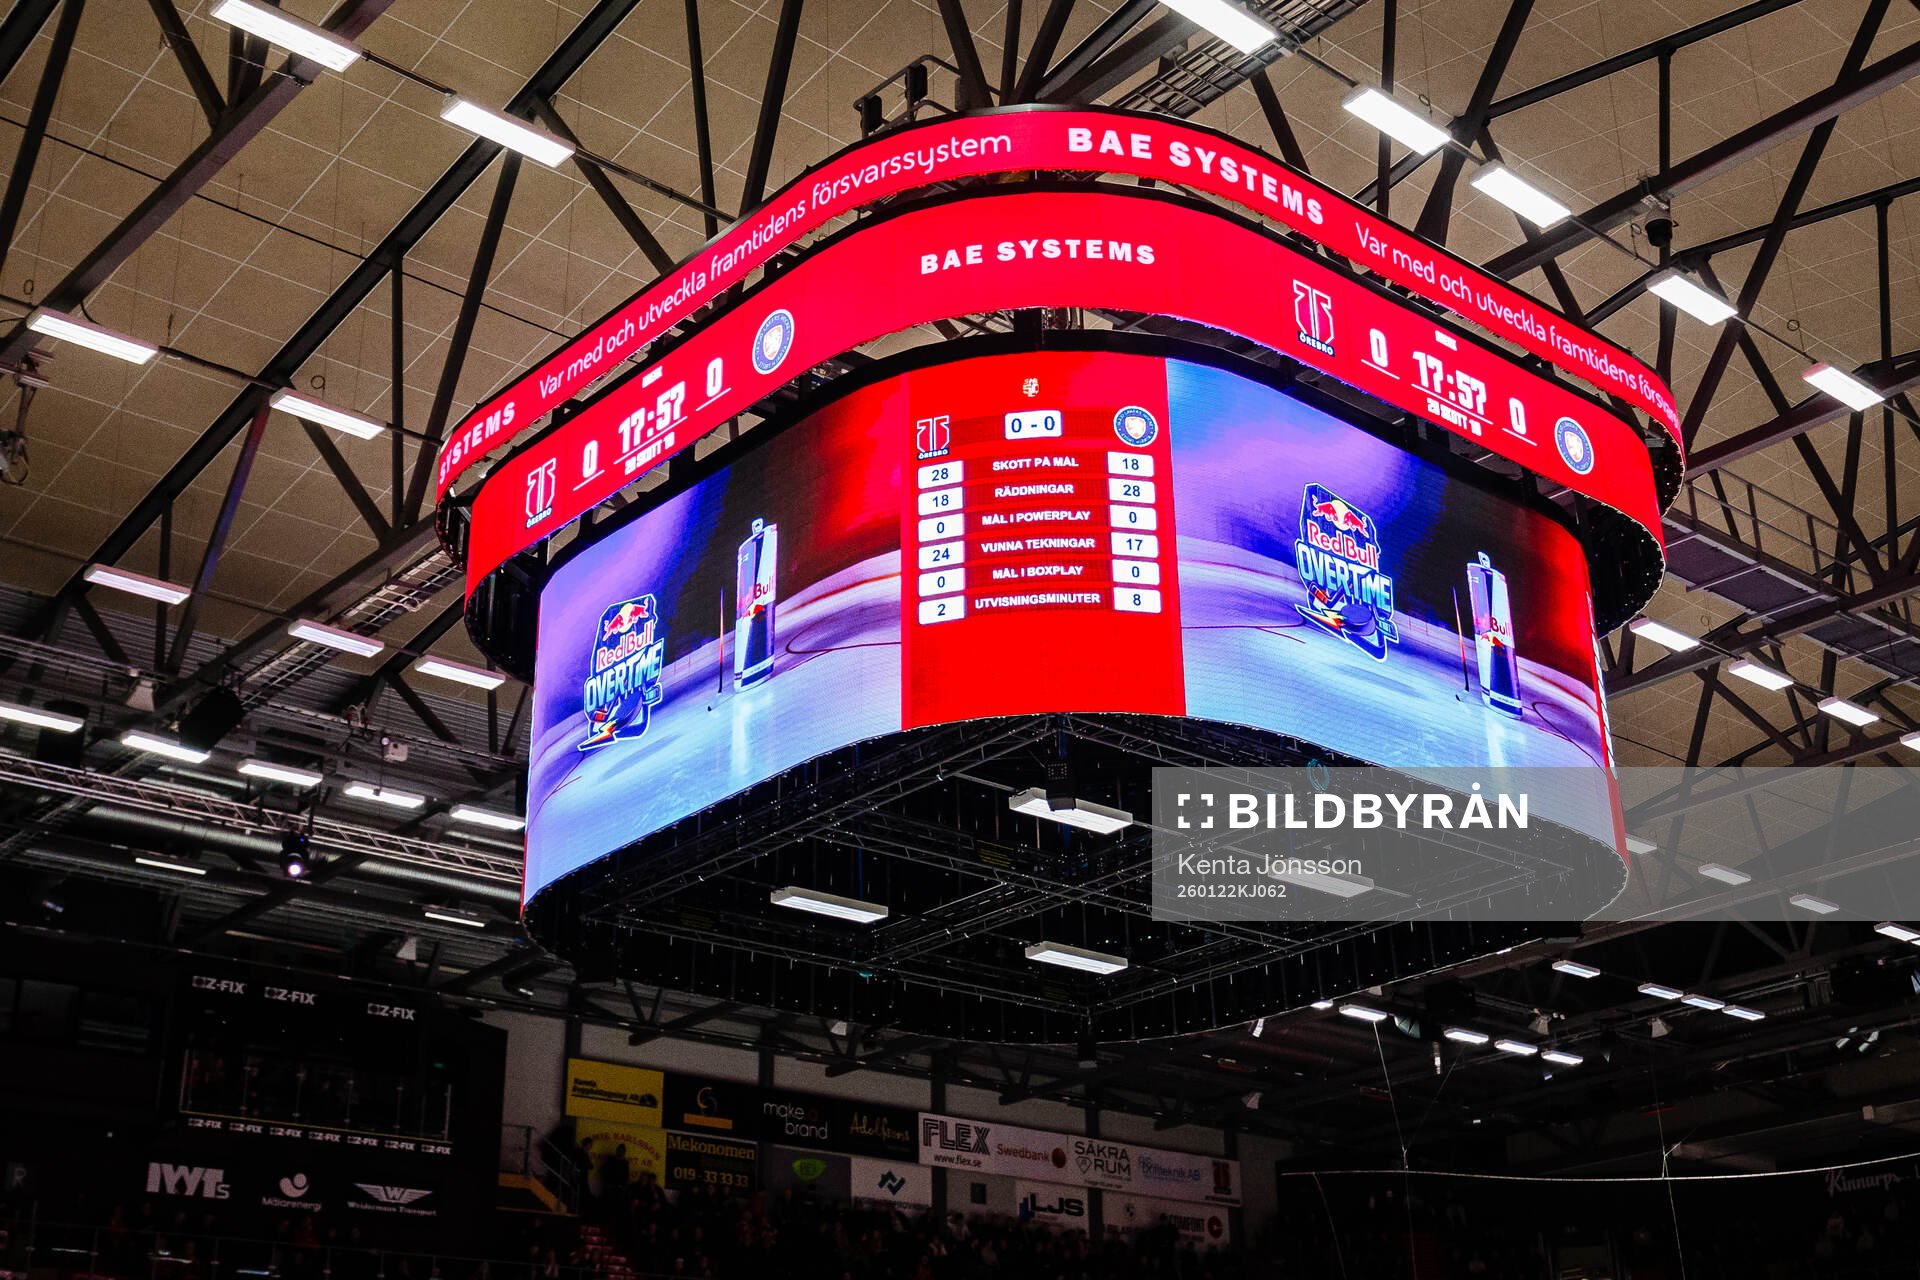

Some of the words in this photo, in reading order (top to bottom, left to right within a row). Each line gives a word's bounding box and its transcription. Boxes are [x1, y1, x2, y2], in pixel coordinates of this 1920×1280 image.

[539, 369, 564, 399] Var
[567, 337, 603, 382] med
[606, 322, 635, 354] och
[639, 272, 706, 330] utveckla
[711, 199, 806, 277] framtidens
[812, 134, 1012, 210] försvarssystem
[921, 244, 984, 275] BAE
[997, 239, 1156, 266] SYSTEMS
[1068, 128, 1153, 160] BAE
[1169, 141, 1324, 225] SYSTEMS
[1355, 222, 1388, 258] Var
[1393, 247, 1435, 286] med
[1440, 272, 1472, 304] och
[1476, 291, 1547, 343] utveckla
[1550, 325, 1638, 390] framtidens
[1299, 331, 1334, 357] ÖREBRO
[1369, 328, 1388, 368] 0
[706, 357, 724, 397] 0
[1412, 351, 1487, 416] 17:57
[618, 381, 686, 454] 17:57
[1011, 418, 1022, 433] 0
[1044, 415, 1056, 431] 0
[1508, 398, 1527, 435] 0
[439, 402, 515, 485] SYSTEMS
[581, 439, 599, 478] 0
[918, 448, 949, 460] ÖREBRO
[992, 457, 1033, 471] SKOTT
[1034, 455, 1051, 468] PÅ
[1053, 454, 1079, 468] MÅL
[1122, 458, 1140, 471] 18
[931, 468, 949, 482] 28
[995, 483, 1074, 498] RÄDDNINGAR
[1123, 484, 1141, 497] 28
[932, 494, 949, 507] 18
[526, 507, 553, 529] ÖREBRO
[982, 512, 1008, 526] MÅL
[1010, 514, 1014, 524] I
[1016, 510, 1091, 523] POWERPLAY
[1128, 511, 1137, 524] 0
[936, 521, 945, 534] 0
[981, 541, 1024, 554] VUNNA
[1025, 537, 1096, 551] TEKNINGAR
[1126, 538, 1143, 551] 17
[1306, 519, 1343, 555] Red
[1345, 536, 1377, 569] Bull
[932, 547, 950, 562] 24
[992, 566, 1018, 580] MÅL
[1020, 568, 1025, 578] I
[1027, 564, 1084, 578] BOXPLAY
[1131, 565, 1140, 578] 0
[1297, 543, 1391, 612] OVERTIME
[937, 576, 946, 588] 0
[975, 593, 1101, 610] UTVISNINGSMINUTER
[1133, 593, 1142, 606] 8
[937, 603, 946, 616] 2
[596, 643, 623, 673] Red
[625, 621, 655, 654] Bull
[586, 639, 664, 713] OVERTIME
[763, 1102, 805, 1120] make
[784, 1116, 829, 1140] brand
[922, 1118, 991, 1156] FLEX
[667, 1135, 756, 1160] Mekonomen
[996, 1143, 1050, 1162] Swedbank
[1074, 1139, 1131, 1162] SÄKRA
[934, 1153, 983, 1168] www.flex.se
[1094, 1157, 1131, 1176] RUM
[673, 1165, 696, 1181] 019
[703, 1169, 718, 1183] 33
[720, 1171, 734, 1185] 33
[734, 1174, 750, 1188] 33
